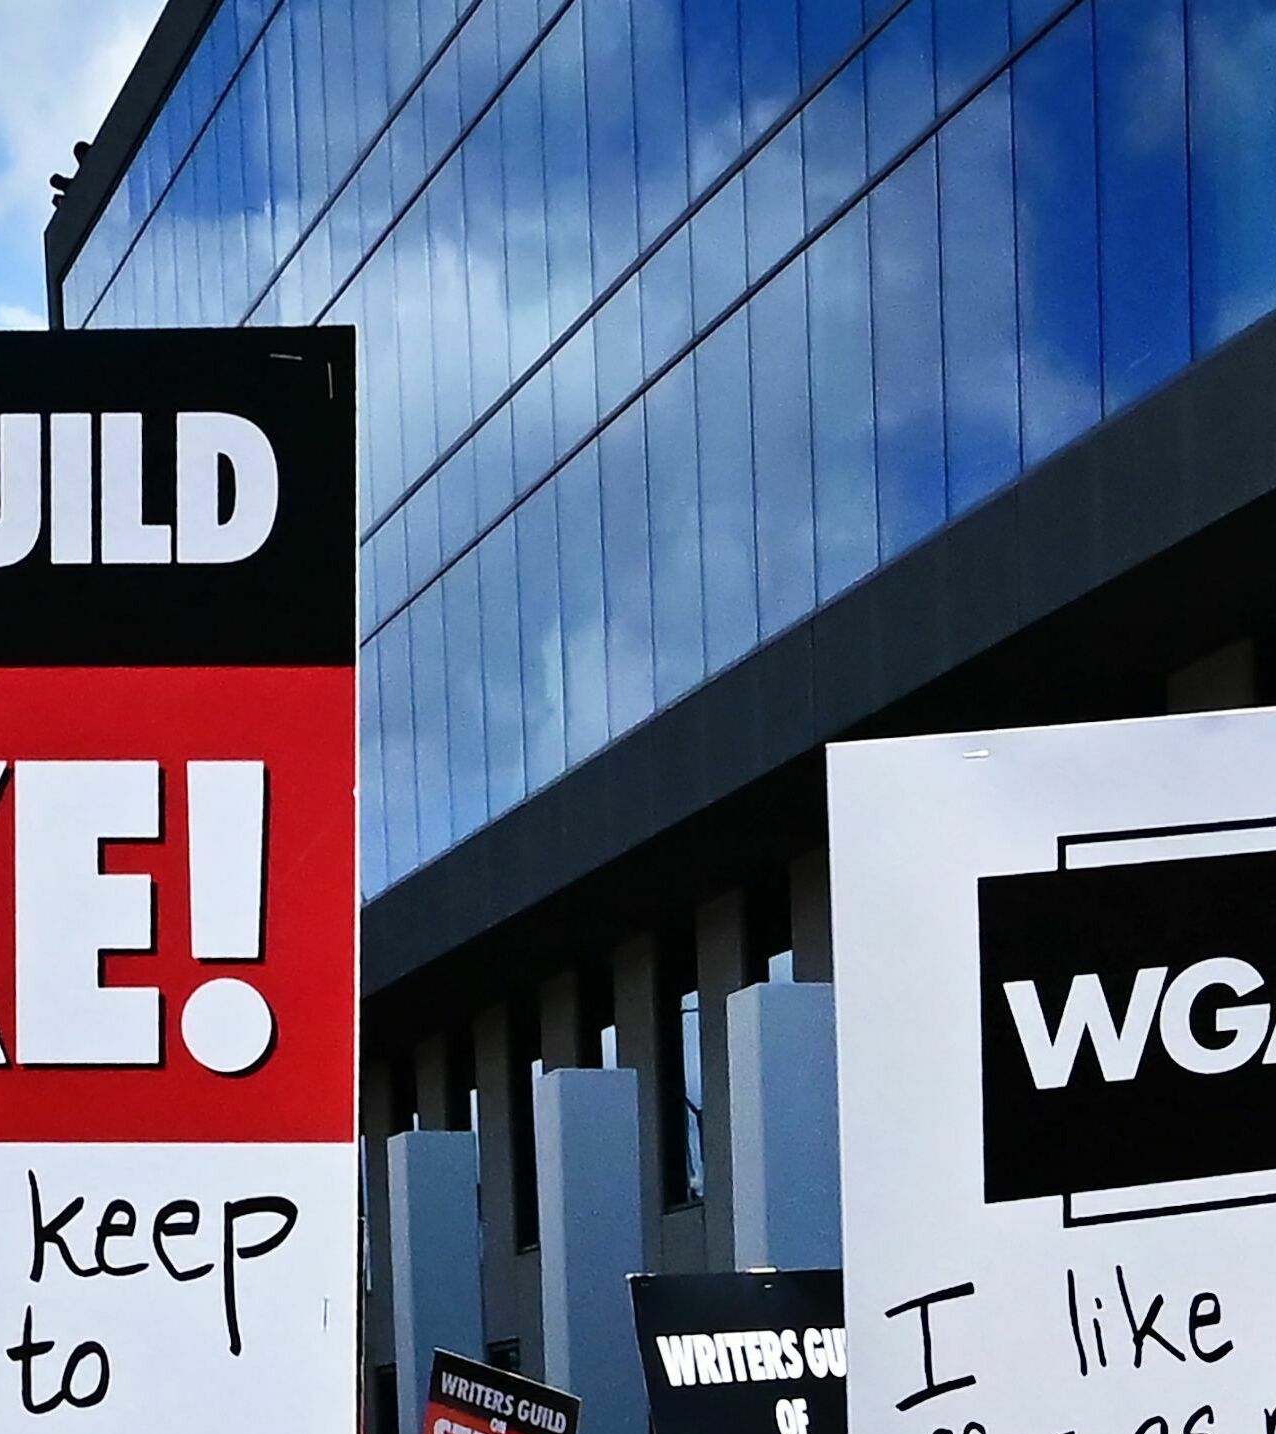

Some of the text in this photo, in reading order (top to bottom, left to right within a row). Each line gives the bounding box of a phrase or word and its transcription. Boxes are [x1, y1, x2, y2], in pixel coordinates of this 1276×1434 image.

[28, 1171, 298, 1354] keep
[7, 1306, 109, 1414] to
[657, 1330, 805, 1386] WRITERS
[885, 1282, 976, 1411] I
[1068, 1265, 1233, 1376] like
[441, 1370, 566, 1433] WRITERS GUILD
